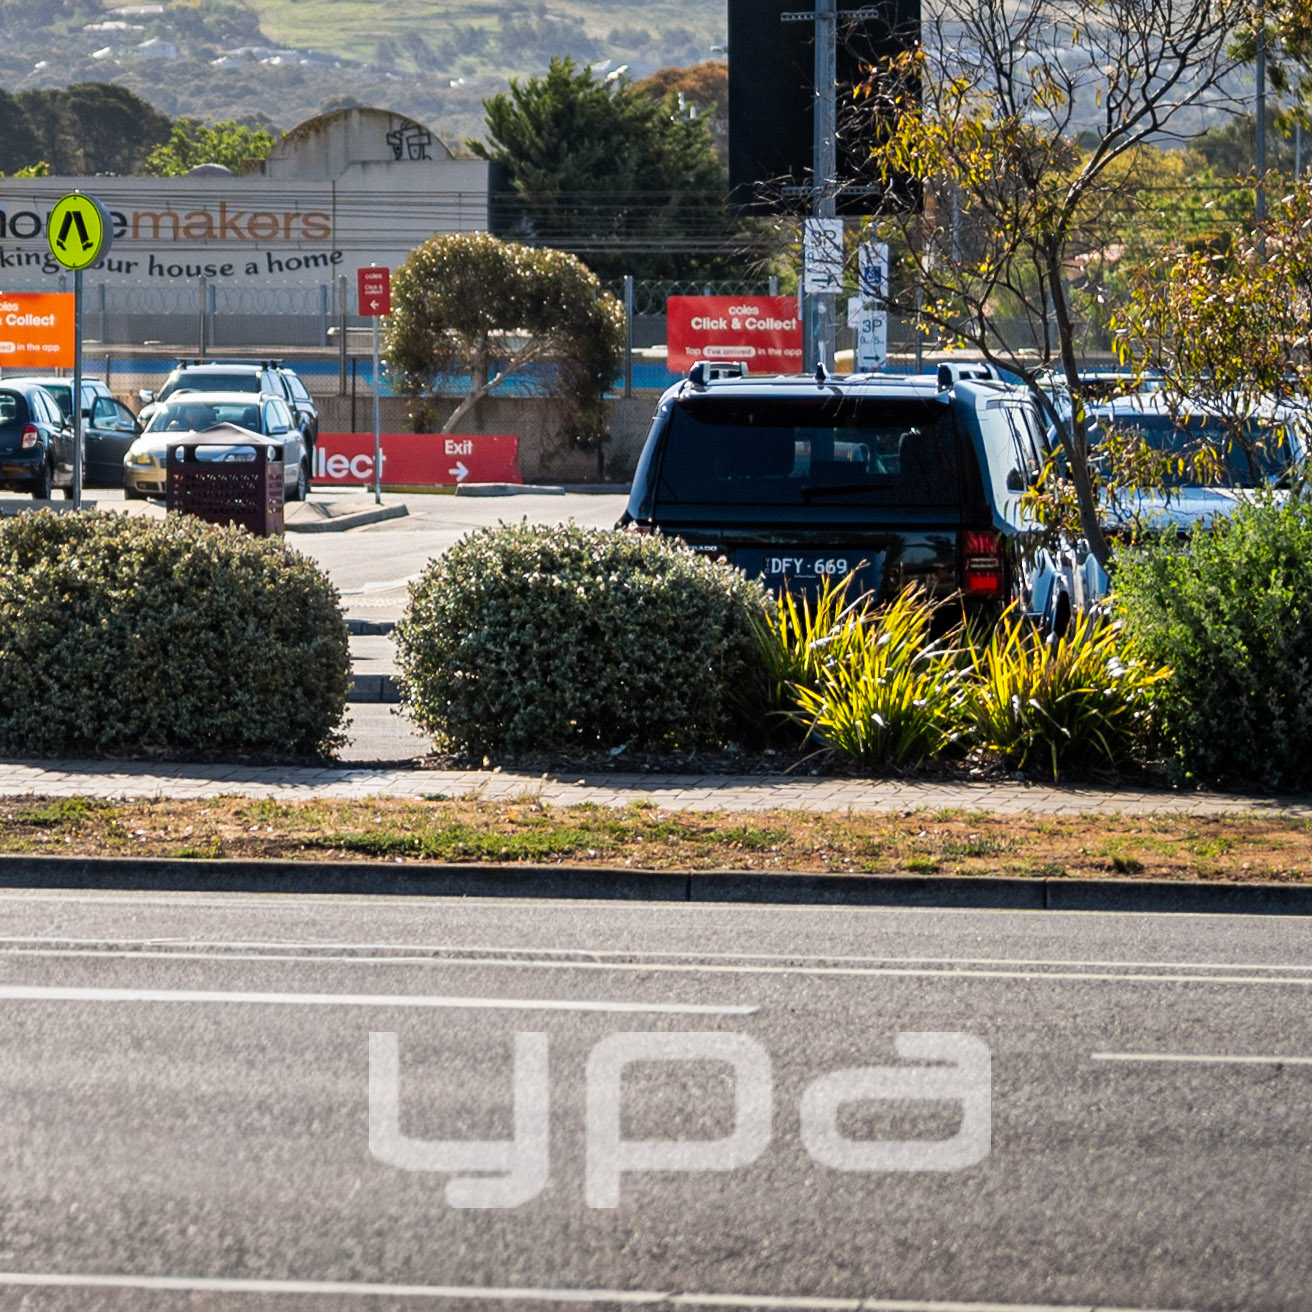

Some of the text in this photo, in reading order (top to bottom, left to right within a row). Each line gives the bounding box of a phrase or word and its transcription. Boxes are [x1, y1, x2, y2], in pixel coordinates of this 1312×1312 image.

[148, 254, 234, 277] house
[245, 262, 259, 275] a
[266, 250, 344, 273] home
[728, 304, 759, 315] coles
[6, 313, 55, 326] Collect
[691, 317, 797, 329] Click & Collect
[862, 319, 882, 333] 3P
[17, 342, 24, 351] in
[27, 342, 40, 351] the
[42, 343, 60, 353] app
[686, 347, 701, 357] Tap
[758, 347, 766, 355] in
[768, 347, 782, 355] the
[784, 349, 803, 357] app
[445, 439, 474, 455] Exit
